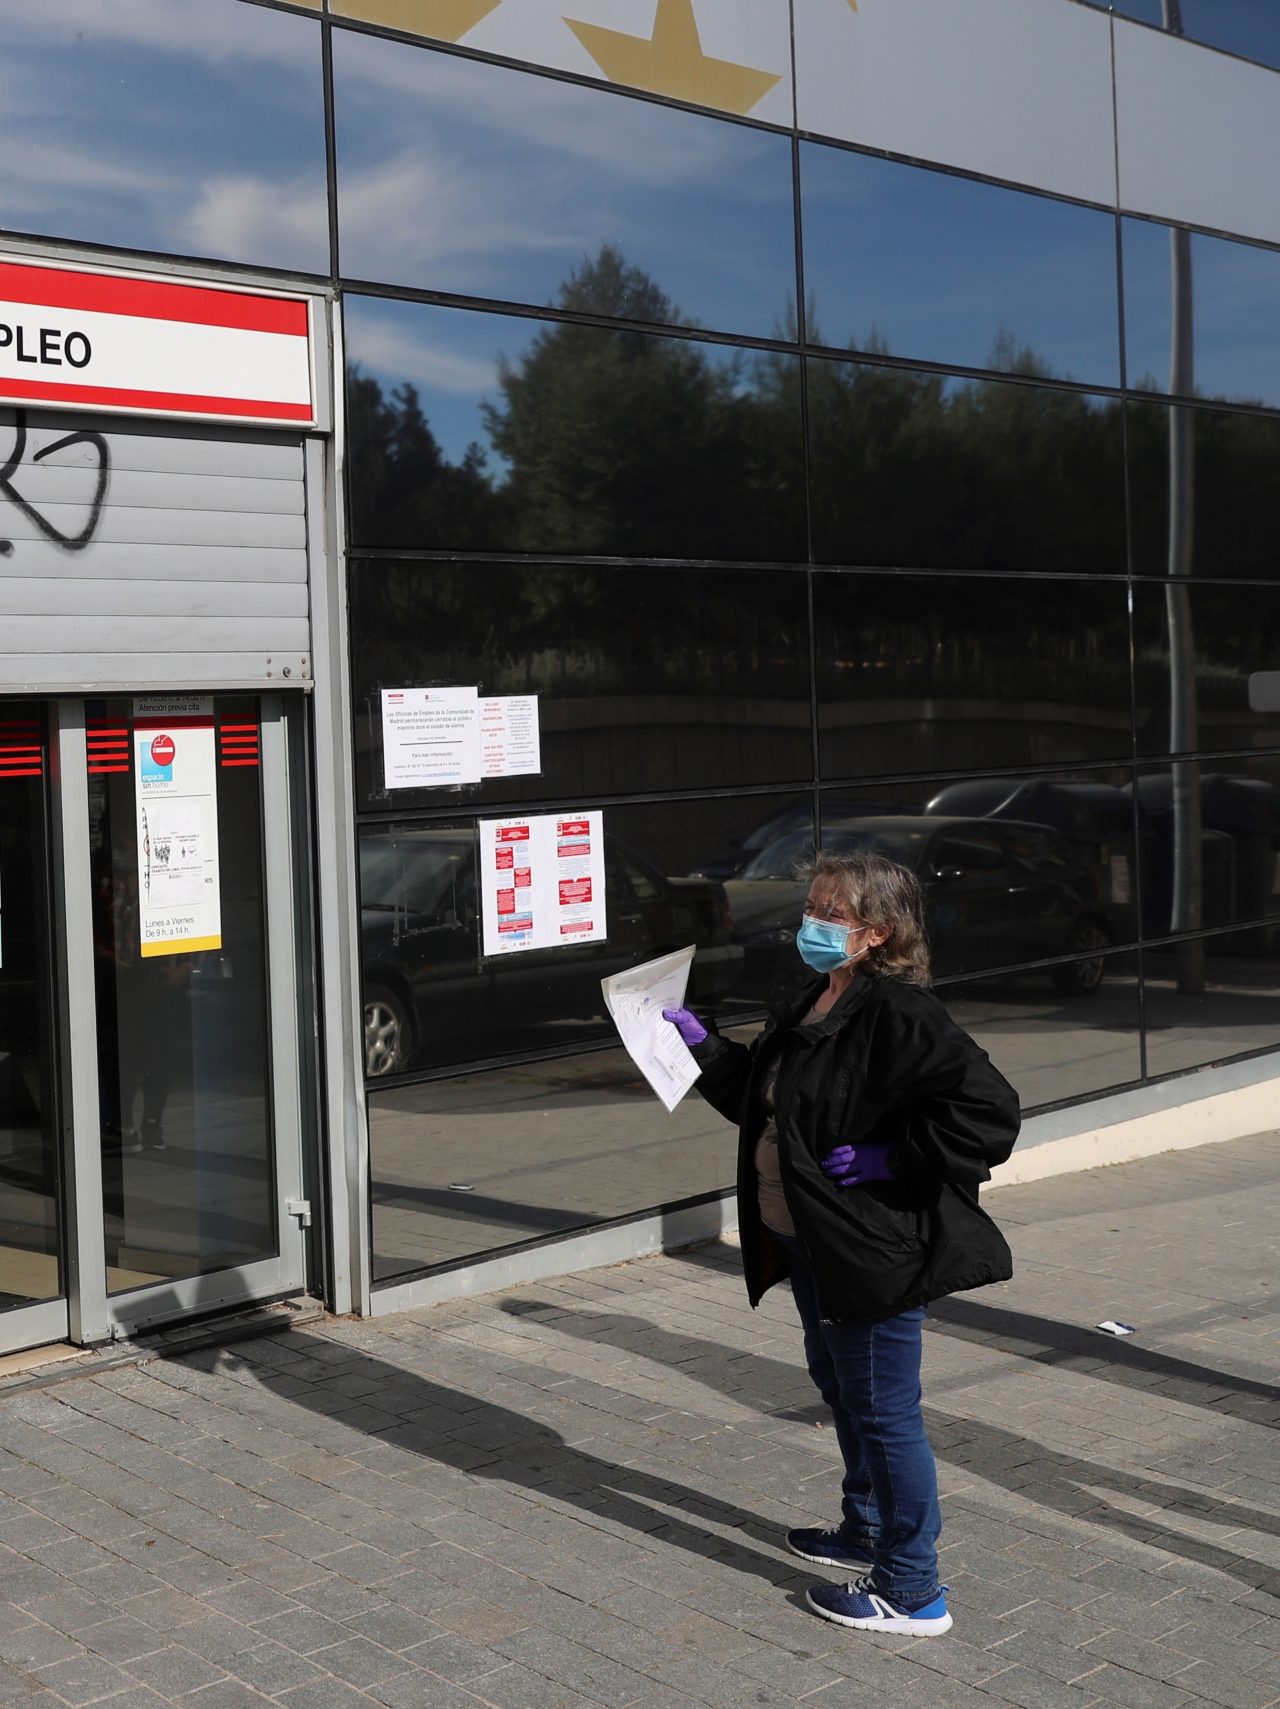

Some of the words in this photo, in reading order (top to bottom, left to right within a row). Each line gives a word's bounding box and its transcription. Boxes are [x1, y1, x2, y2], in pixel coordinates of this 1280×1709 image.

[138, 703, 167, 712] Atención
[168, 704, 187, 712] previa
[188, 703, 200, 711] cita
[142, 772, 164, 782] espacio
[145, 920, 165, 928] Lunes
[171, 917, 195, 925] Viernes
[145, 929, 155, 938] De
[155, 929, 161, 937] 9
[175, 926, 183, 935] 14
